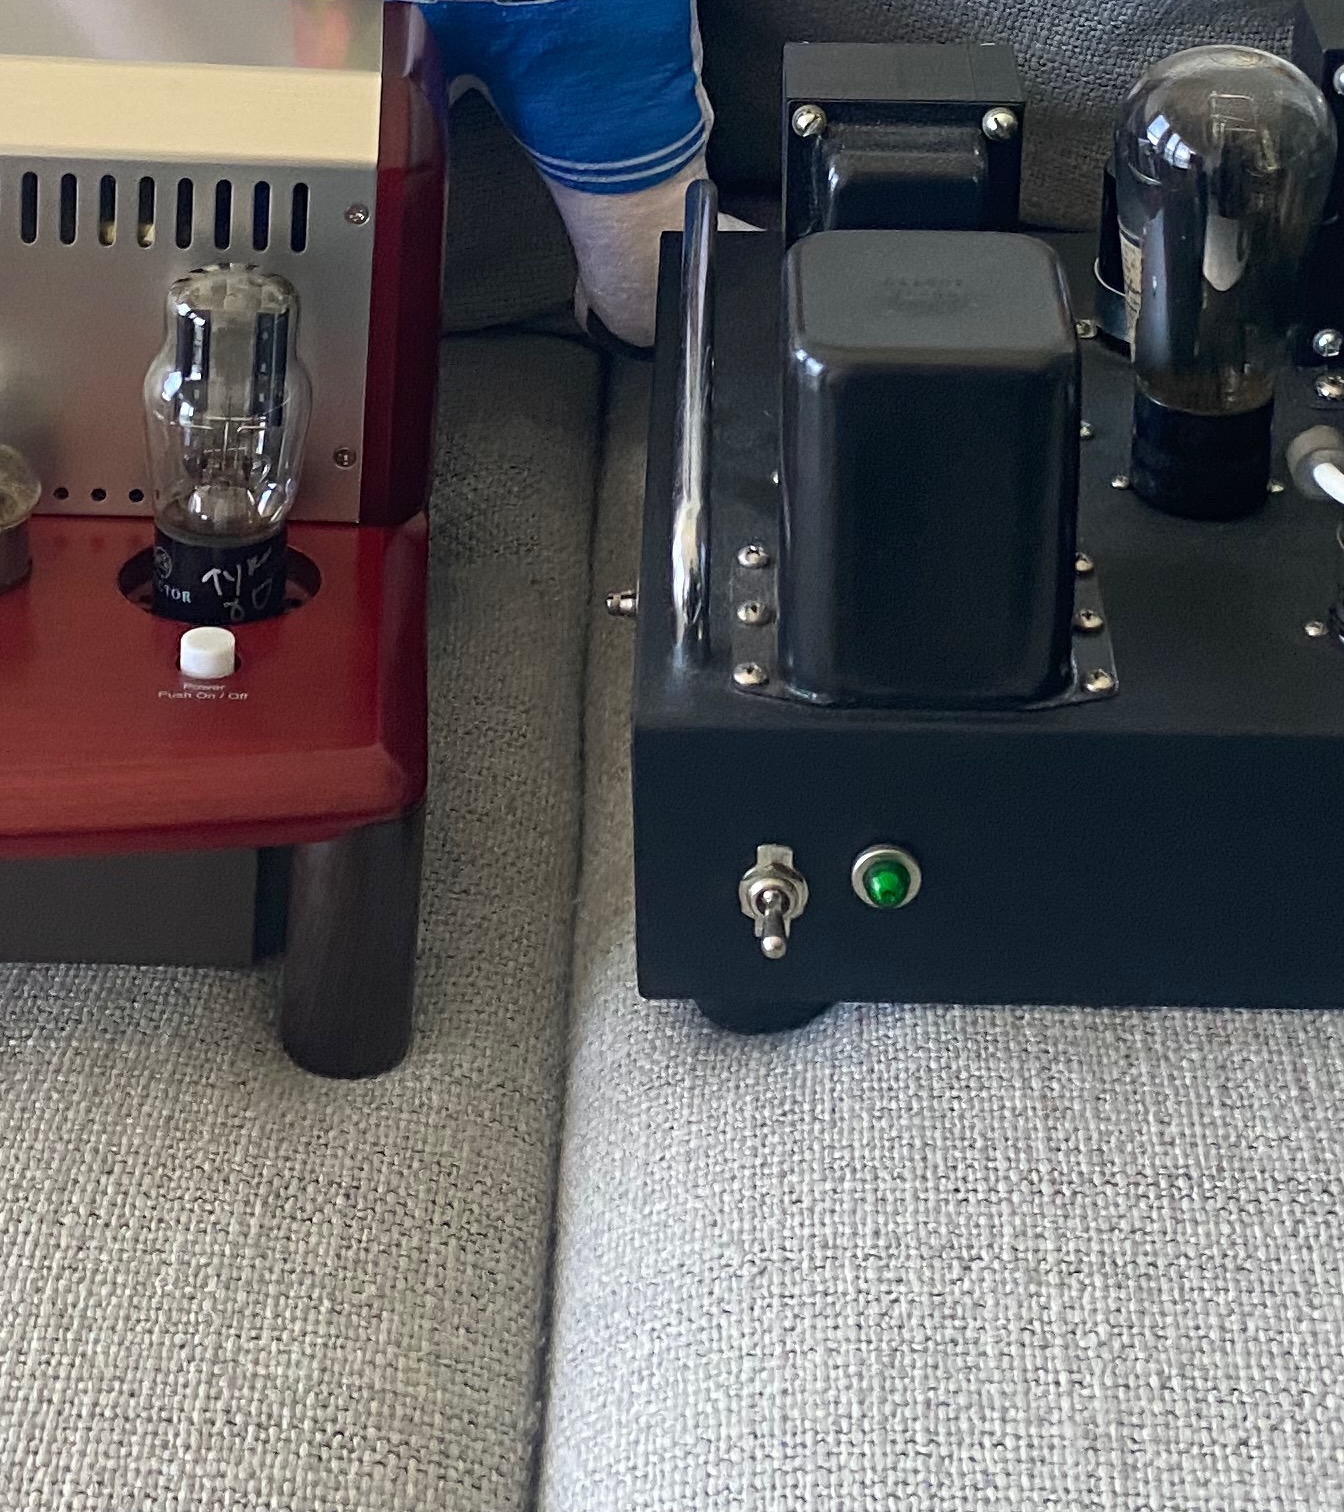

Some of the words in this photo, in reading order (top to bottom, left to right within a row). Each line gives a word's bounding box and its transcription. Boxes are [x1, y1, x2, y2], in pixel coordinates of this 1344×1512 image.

[158, 690, 192, 699] Push
[196, 691, 217, 699] On
[228, 691, 249, 700] Off
